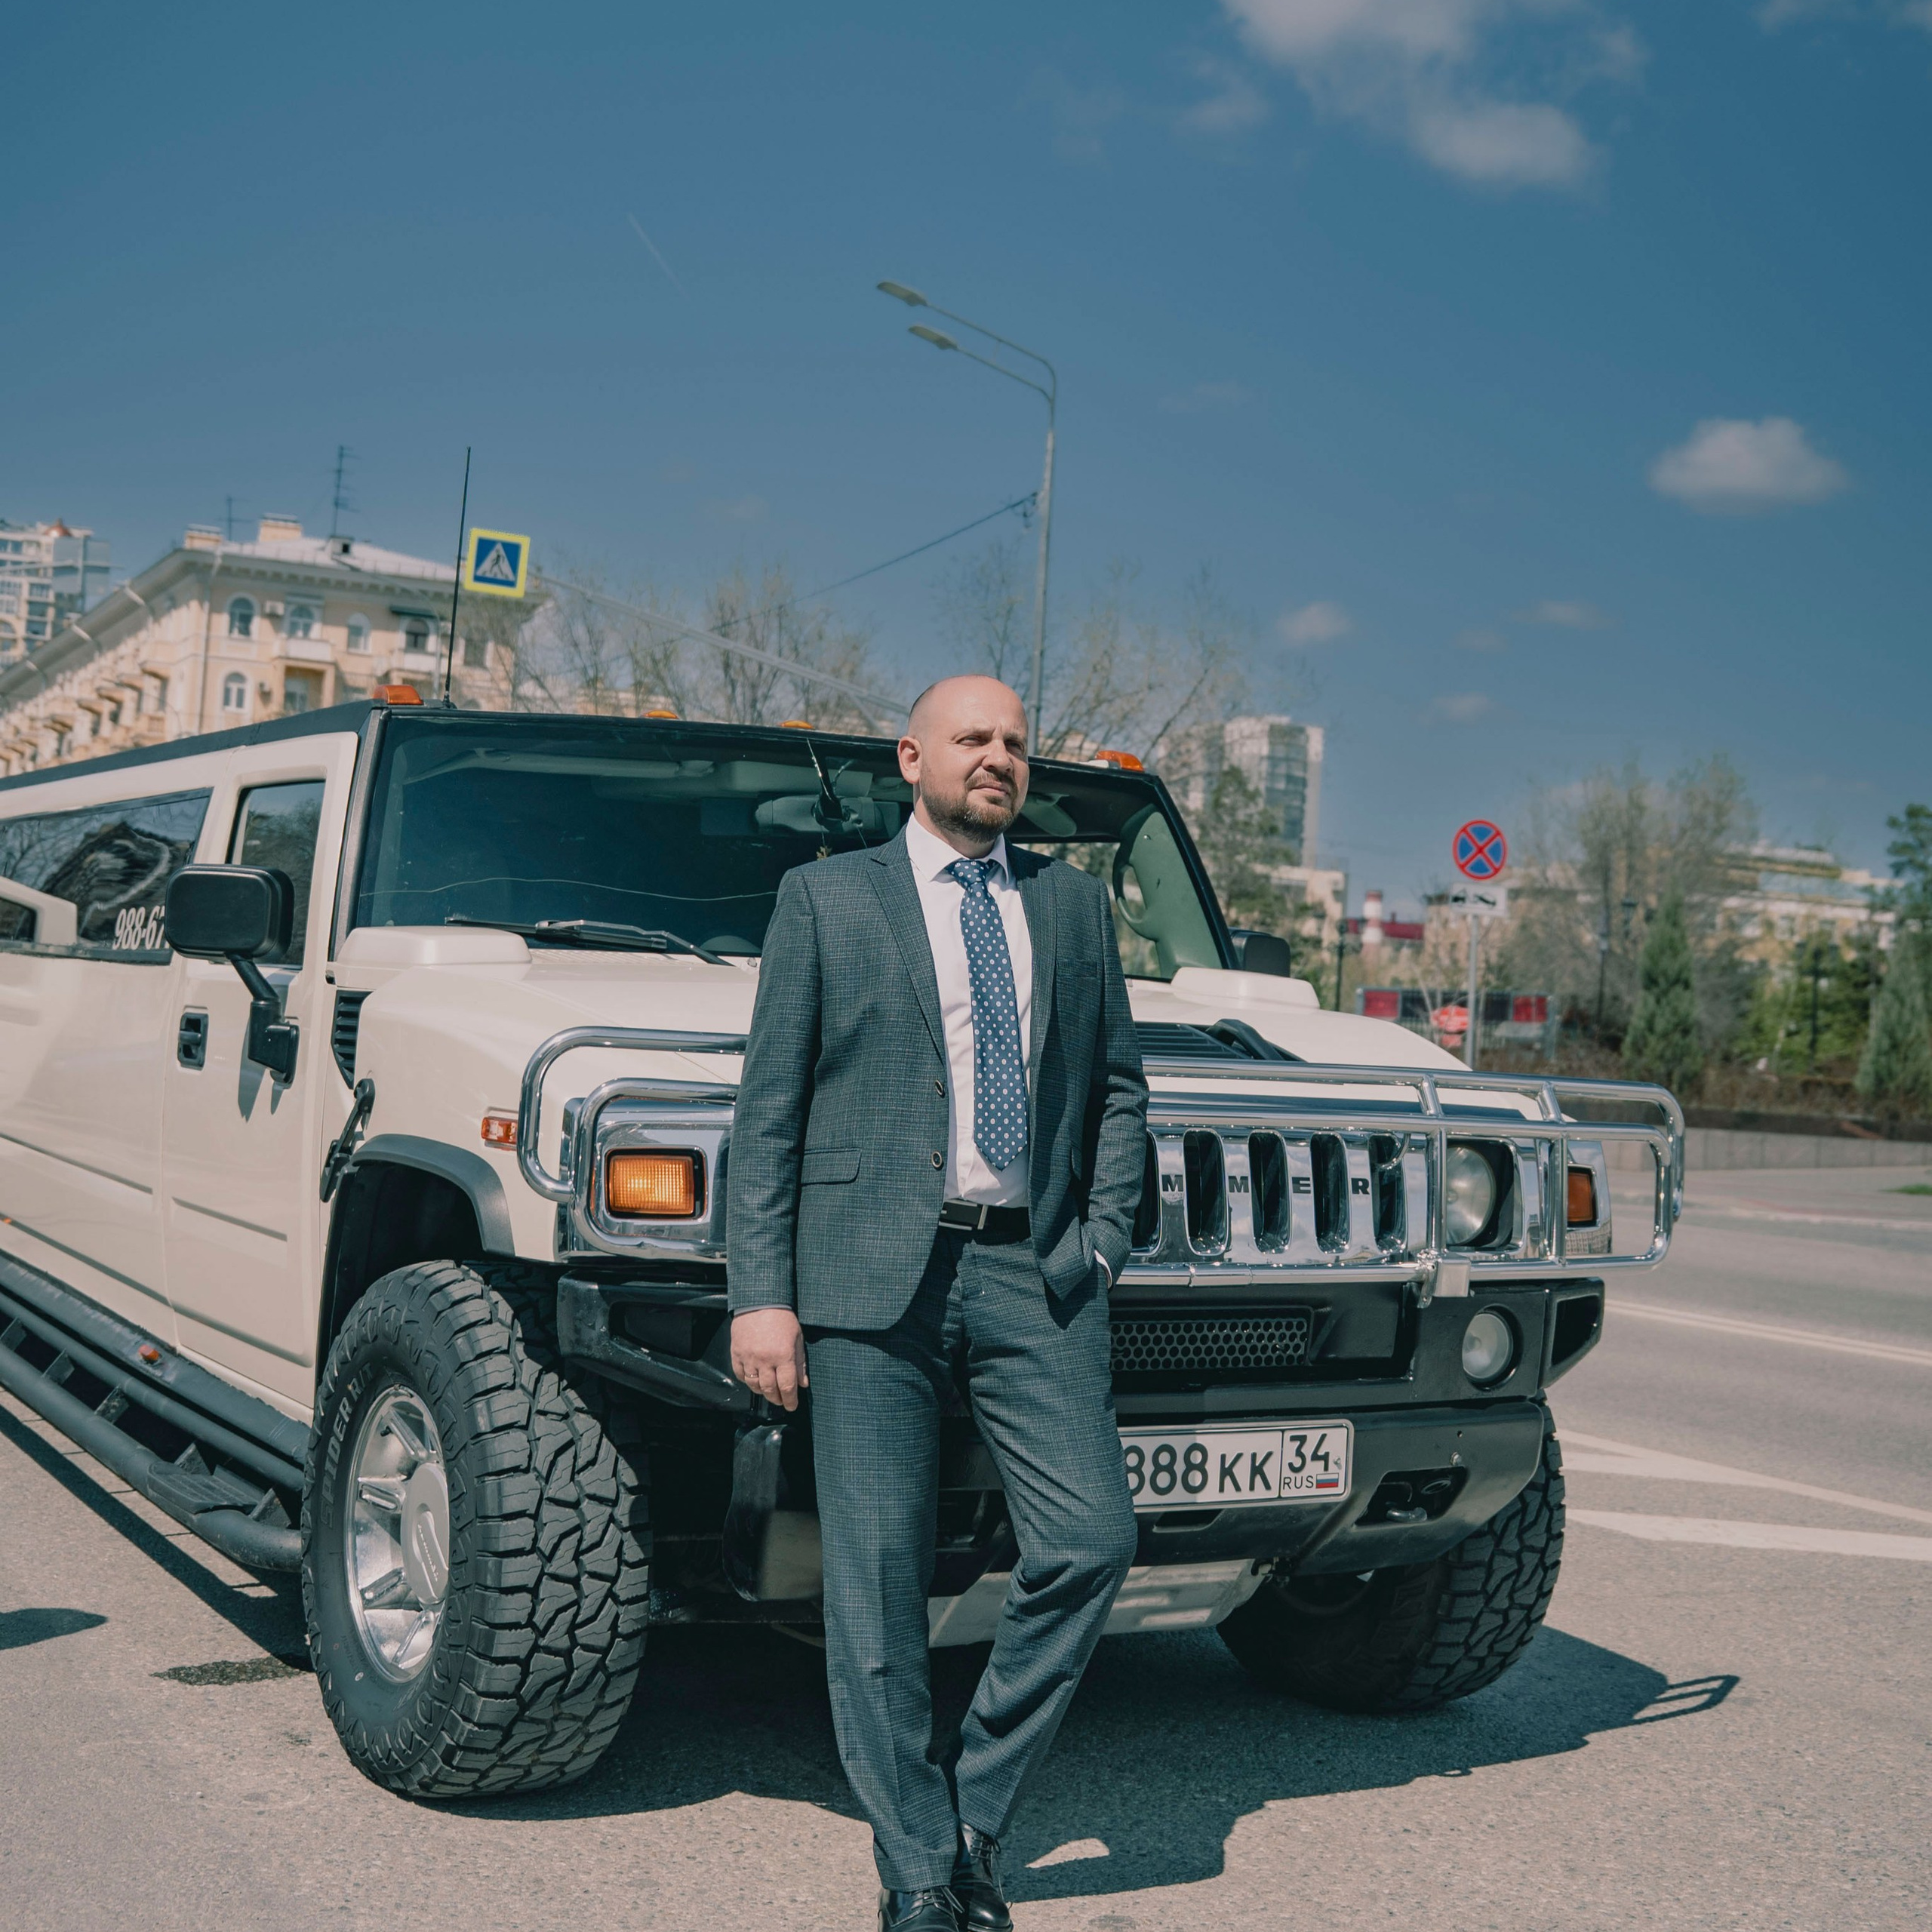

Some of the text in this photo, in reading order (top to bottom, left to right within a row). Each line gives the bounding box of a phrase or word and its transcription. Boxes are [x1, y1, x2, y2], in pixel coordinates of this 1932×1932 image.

[112, 905, 170, 950] 988-67
[320, 1361, 374, 1529] SPIDER R/T
[1287, 1432, 1331, 1473] 34
[1283, 1475, 1314, 1491] RUS
